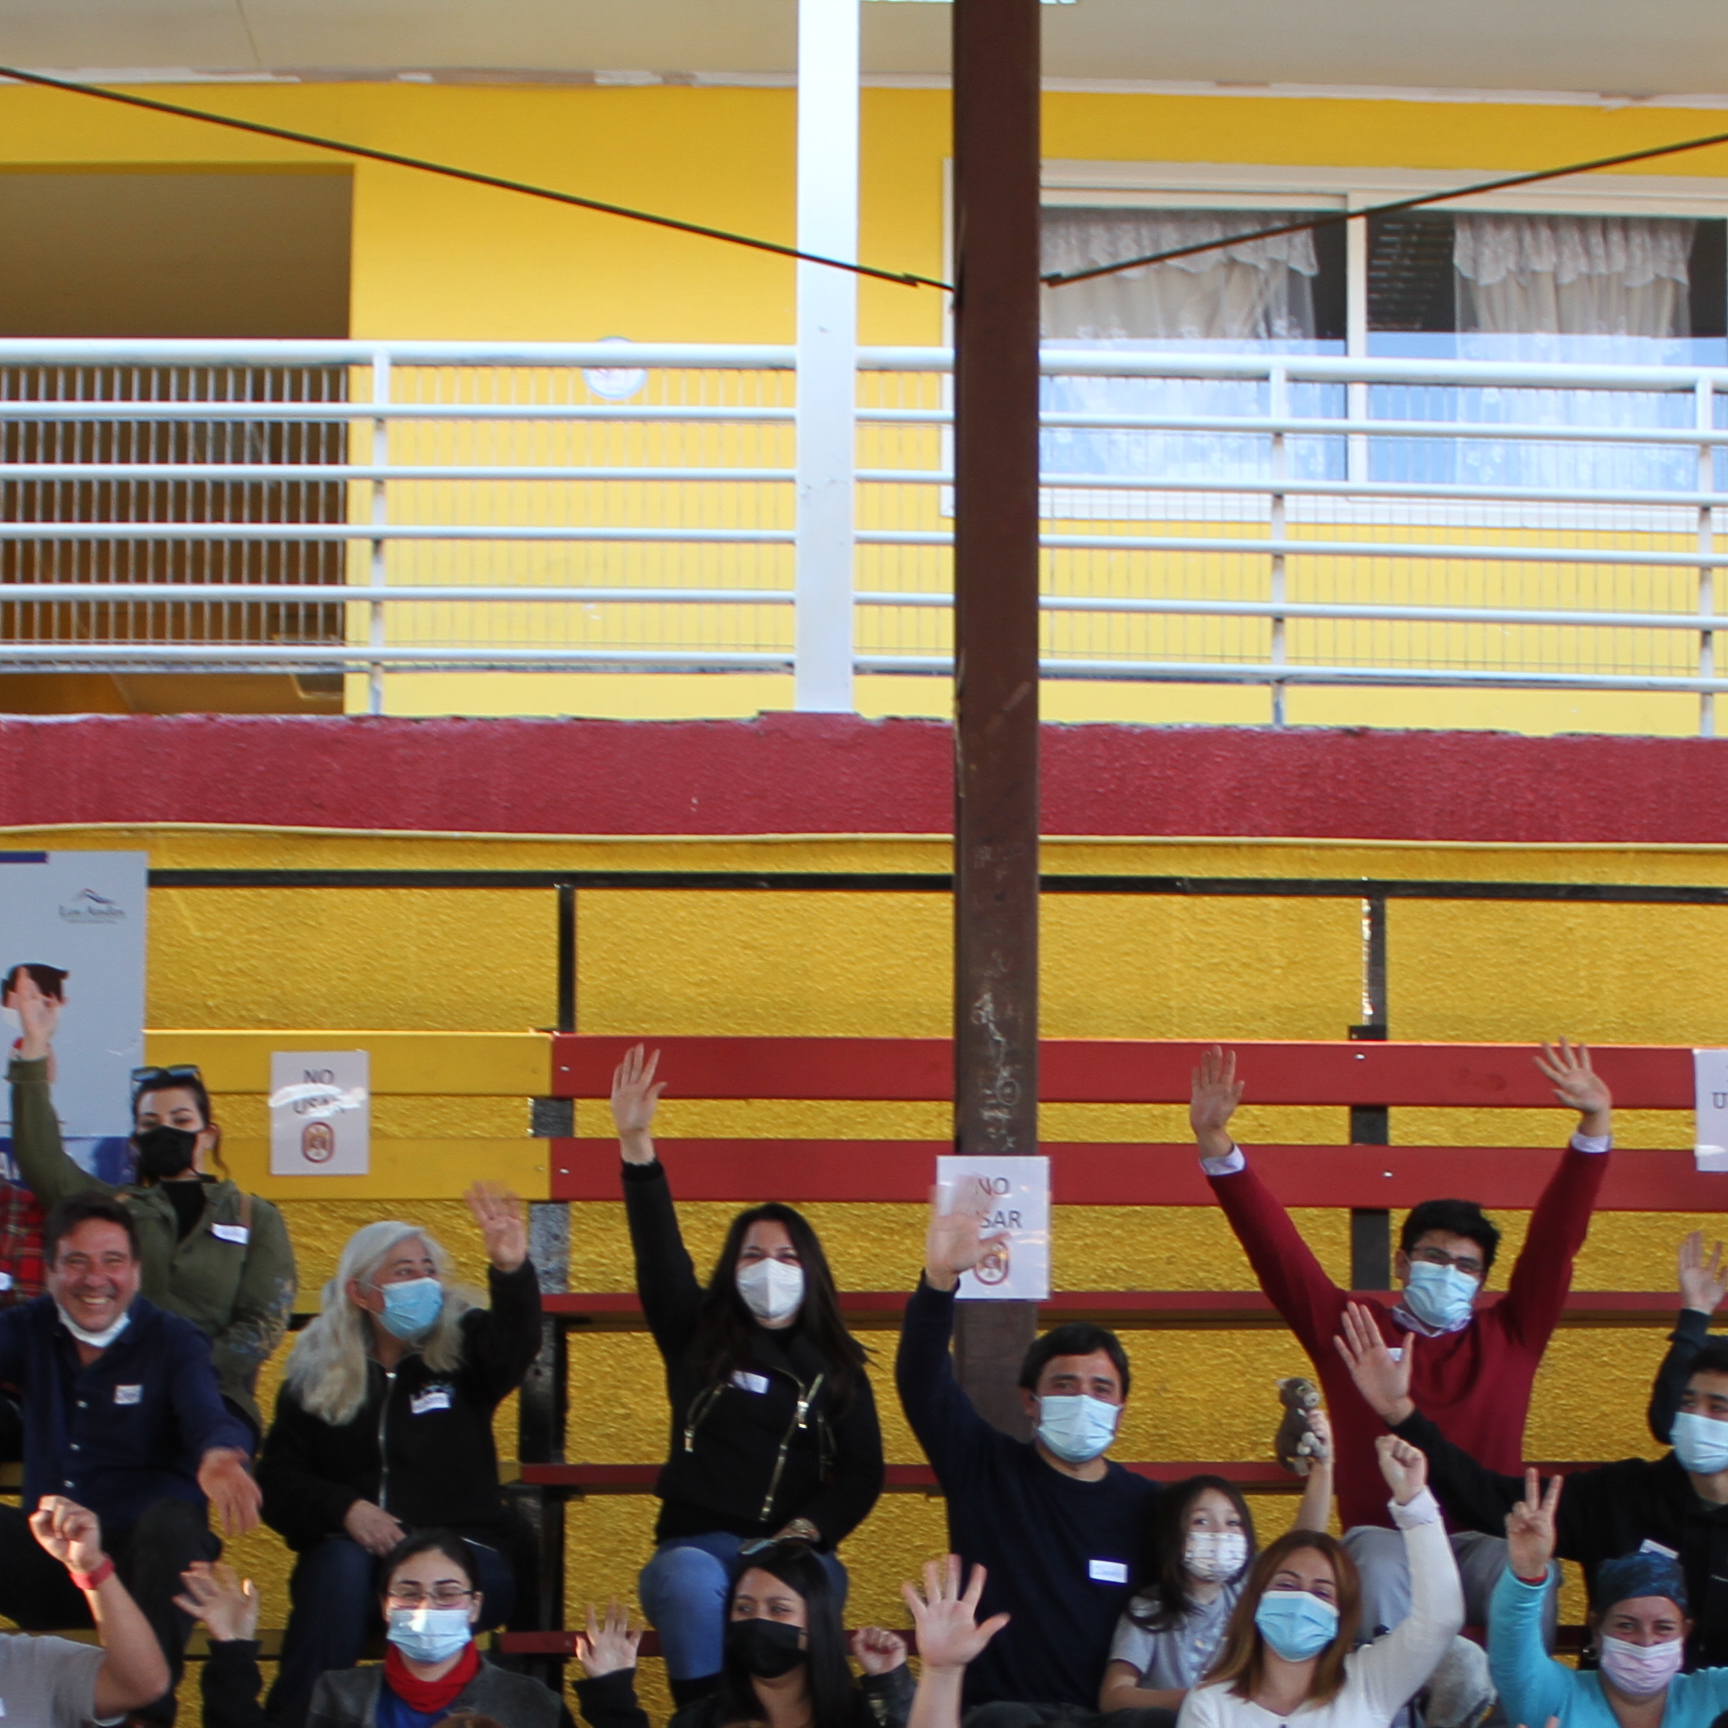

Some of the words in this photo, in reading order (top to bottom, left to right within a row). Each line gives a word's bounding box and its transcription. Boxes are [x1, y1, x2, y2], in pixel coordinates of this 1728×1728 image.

[304, 1069, 335, 1083] NO
[975, 1177, 1011, 1196] NO
[975, 1209, 1023, 1229] SAR
